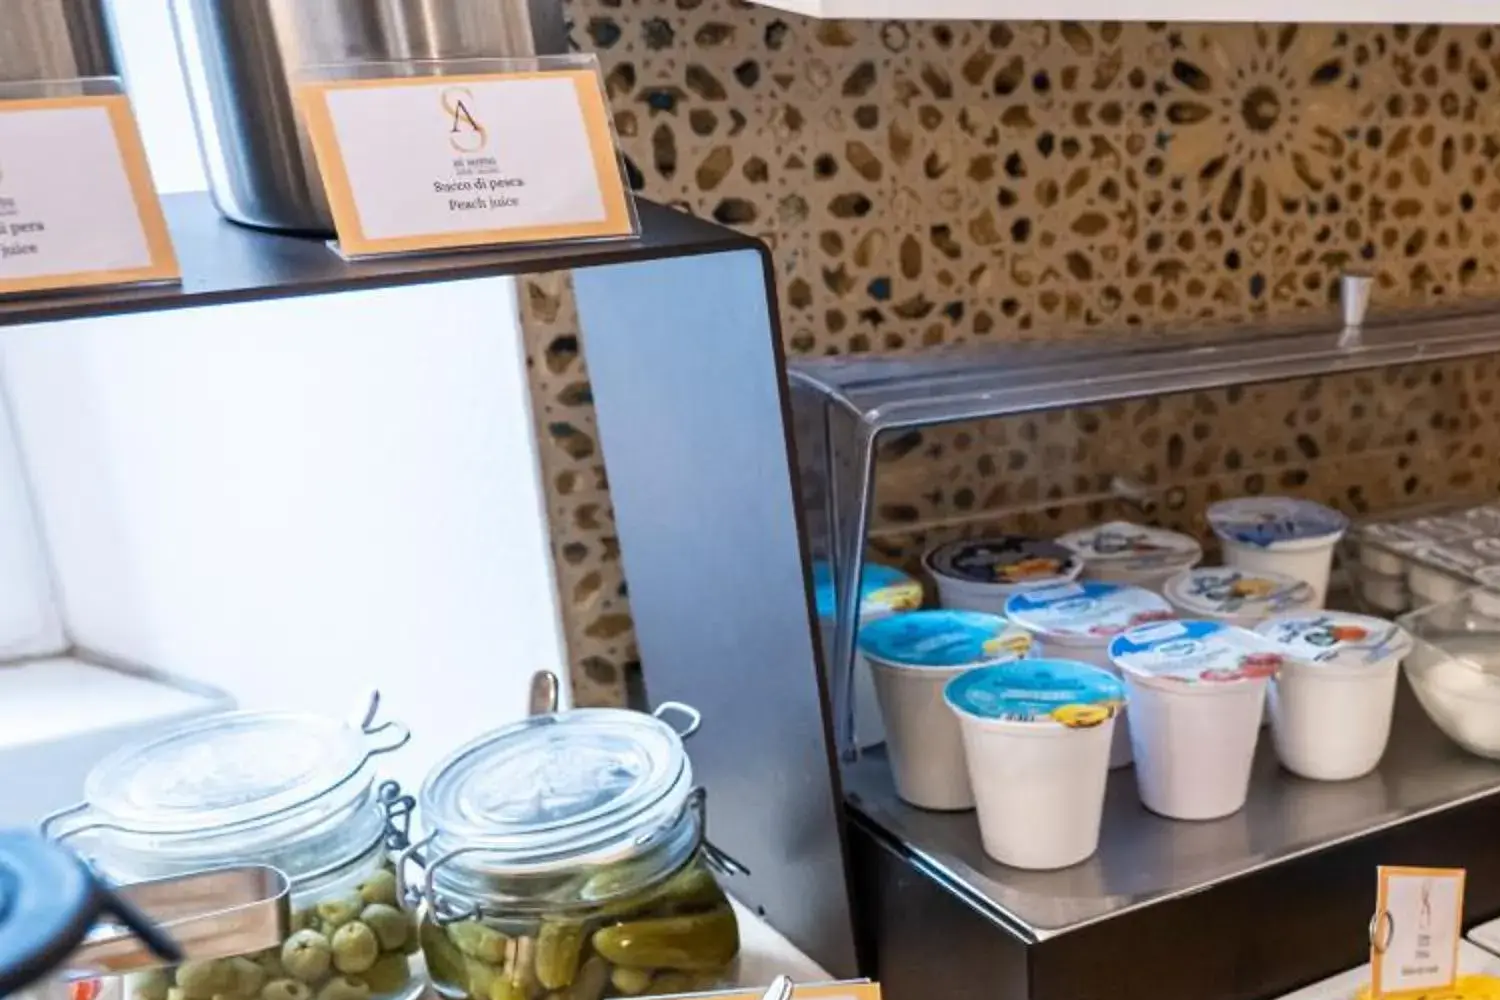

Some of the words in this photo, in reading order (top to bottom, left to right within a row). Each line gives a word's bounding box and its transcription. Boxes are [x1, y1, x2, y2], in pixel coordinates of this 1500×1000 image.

[433, 180, 471, 192] Succo
[474, 177, 487, 190] di
[489, 178, 525, 192] pesca
[448, 197, 487, 211] Peach
[489, 195, 519, 209] juice
[9, 221, 45, 237] pera
[1, 243, 38, 259] juice
